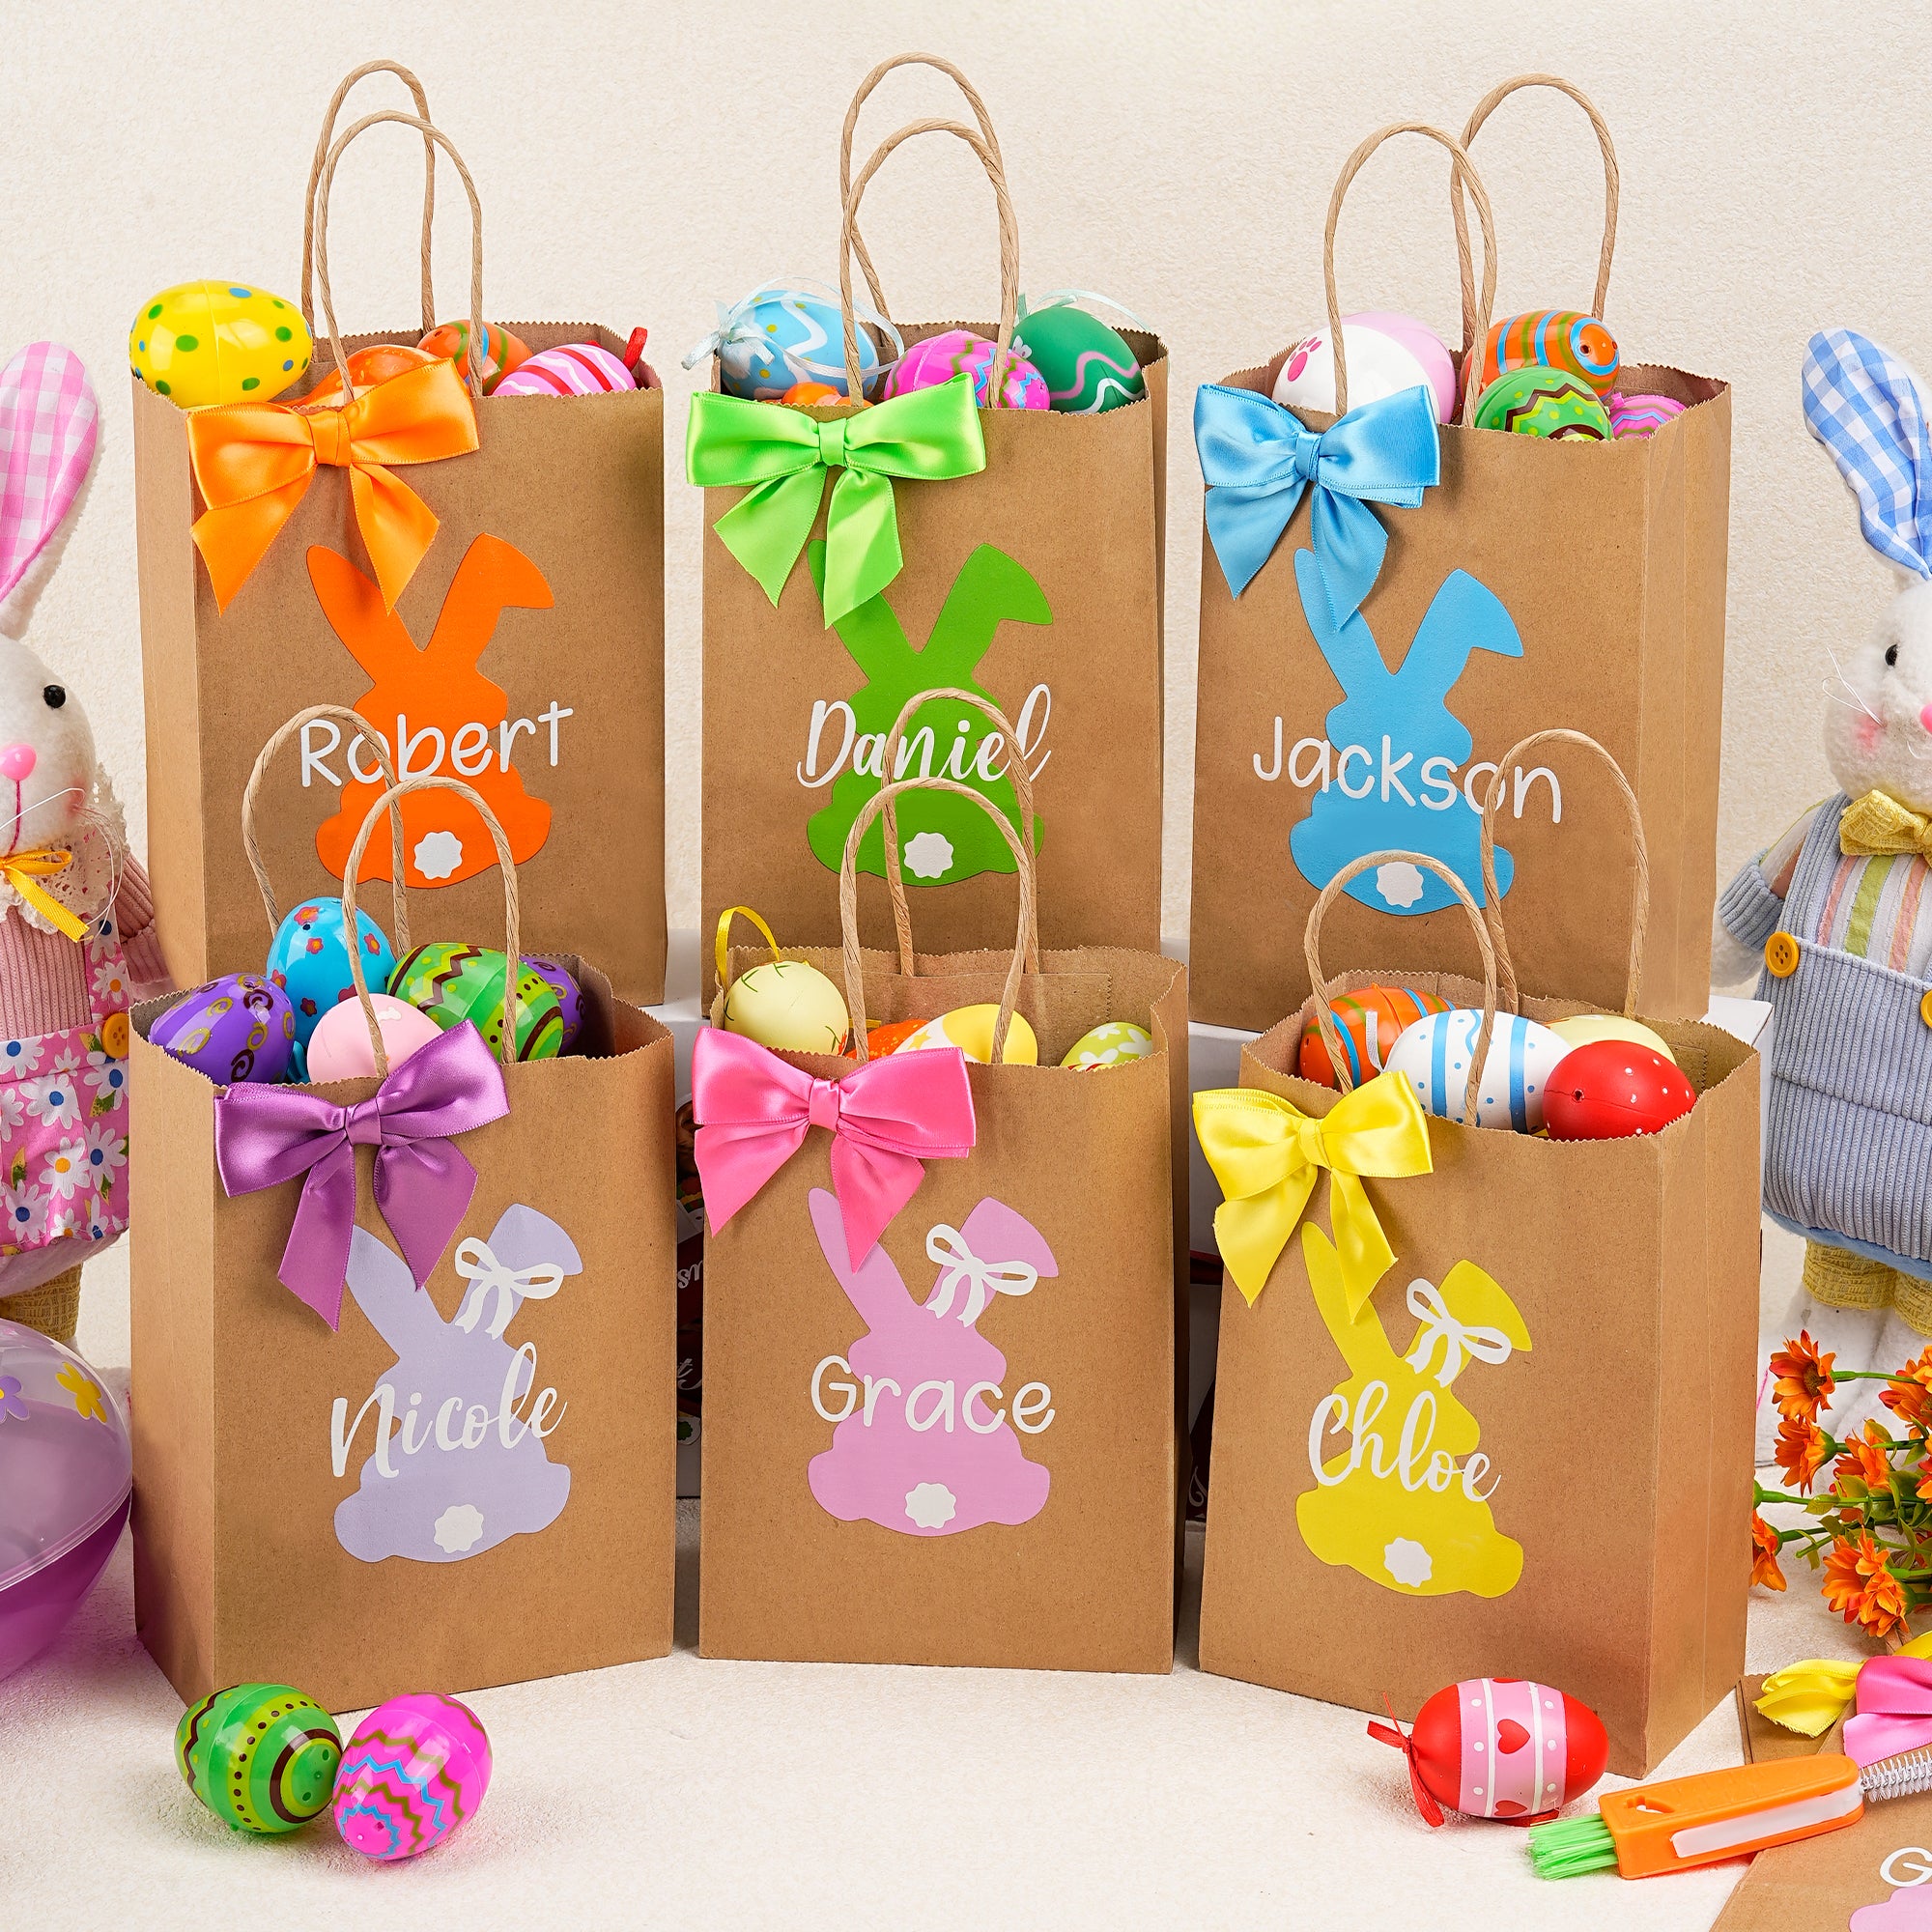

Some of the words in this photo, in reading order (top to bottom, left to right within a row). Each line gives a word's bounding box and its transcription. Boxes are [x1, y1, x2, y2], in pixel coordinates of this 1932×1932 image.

[299, 700, 574, 788] Robert
[796, 683, 1052, 788] Daniel
[1253, 716, 1562, 824] Jackson
[330, 1341, 568, 1479] Nicole
[810, 1354, 1056, 1435] Grace
[1308, 1379, 1502, 1502] Chloe
